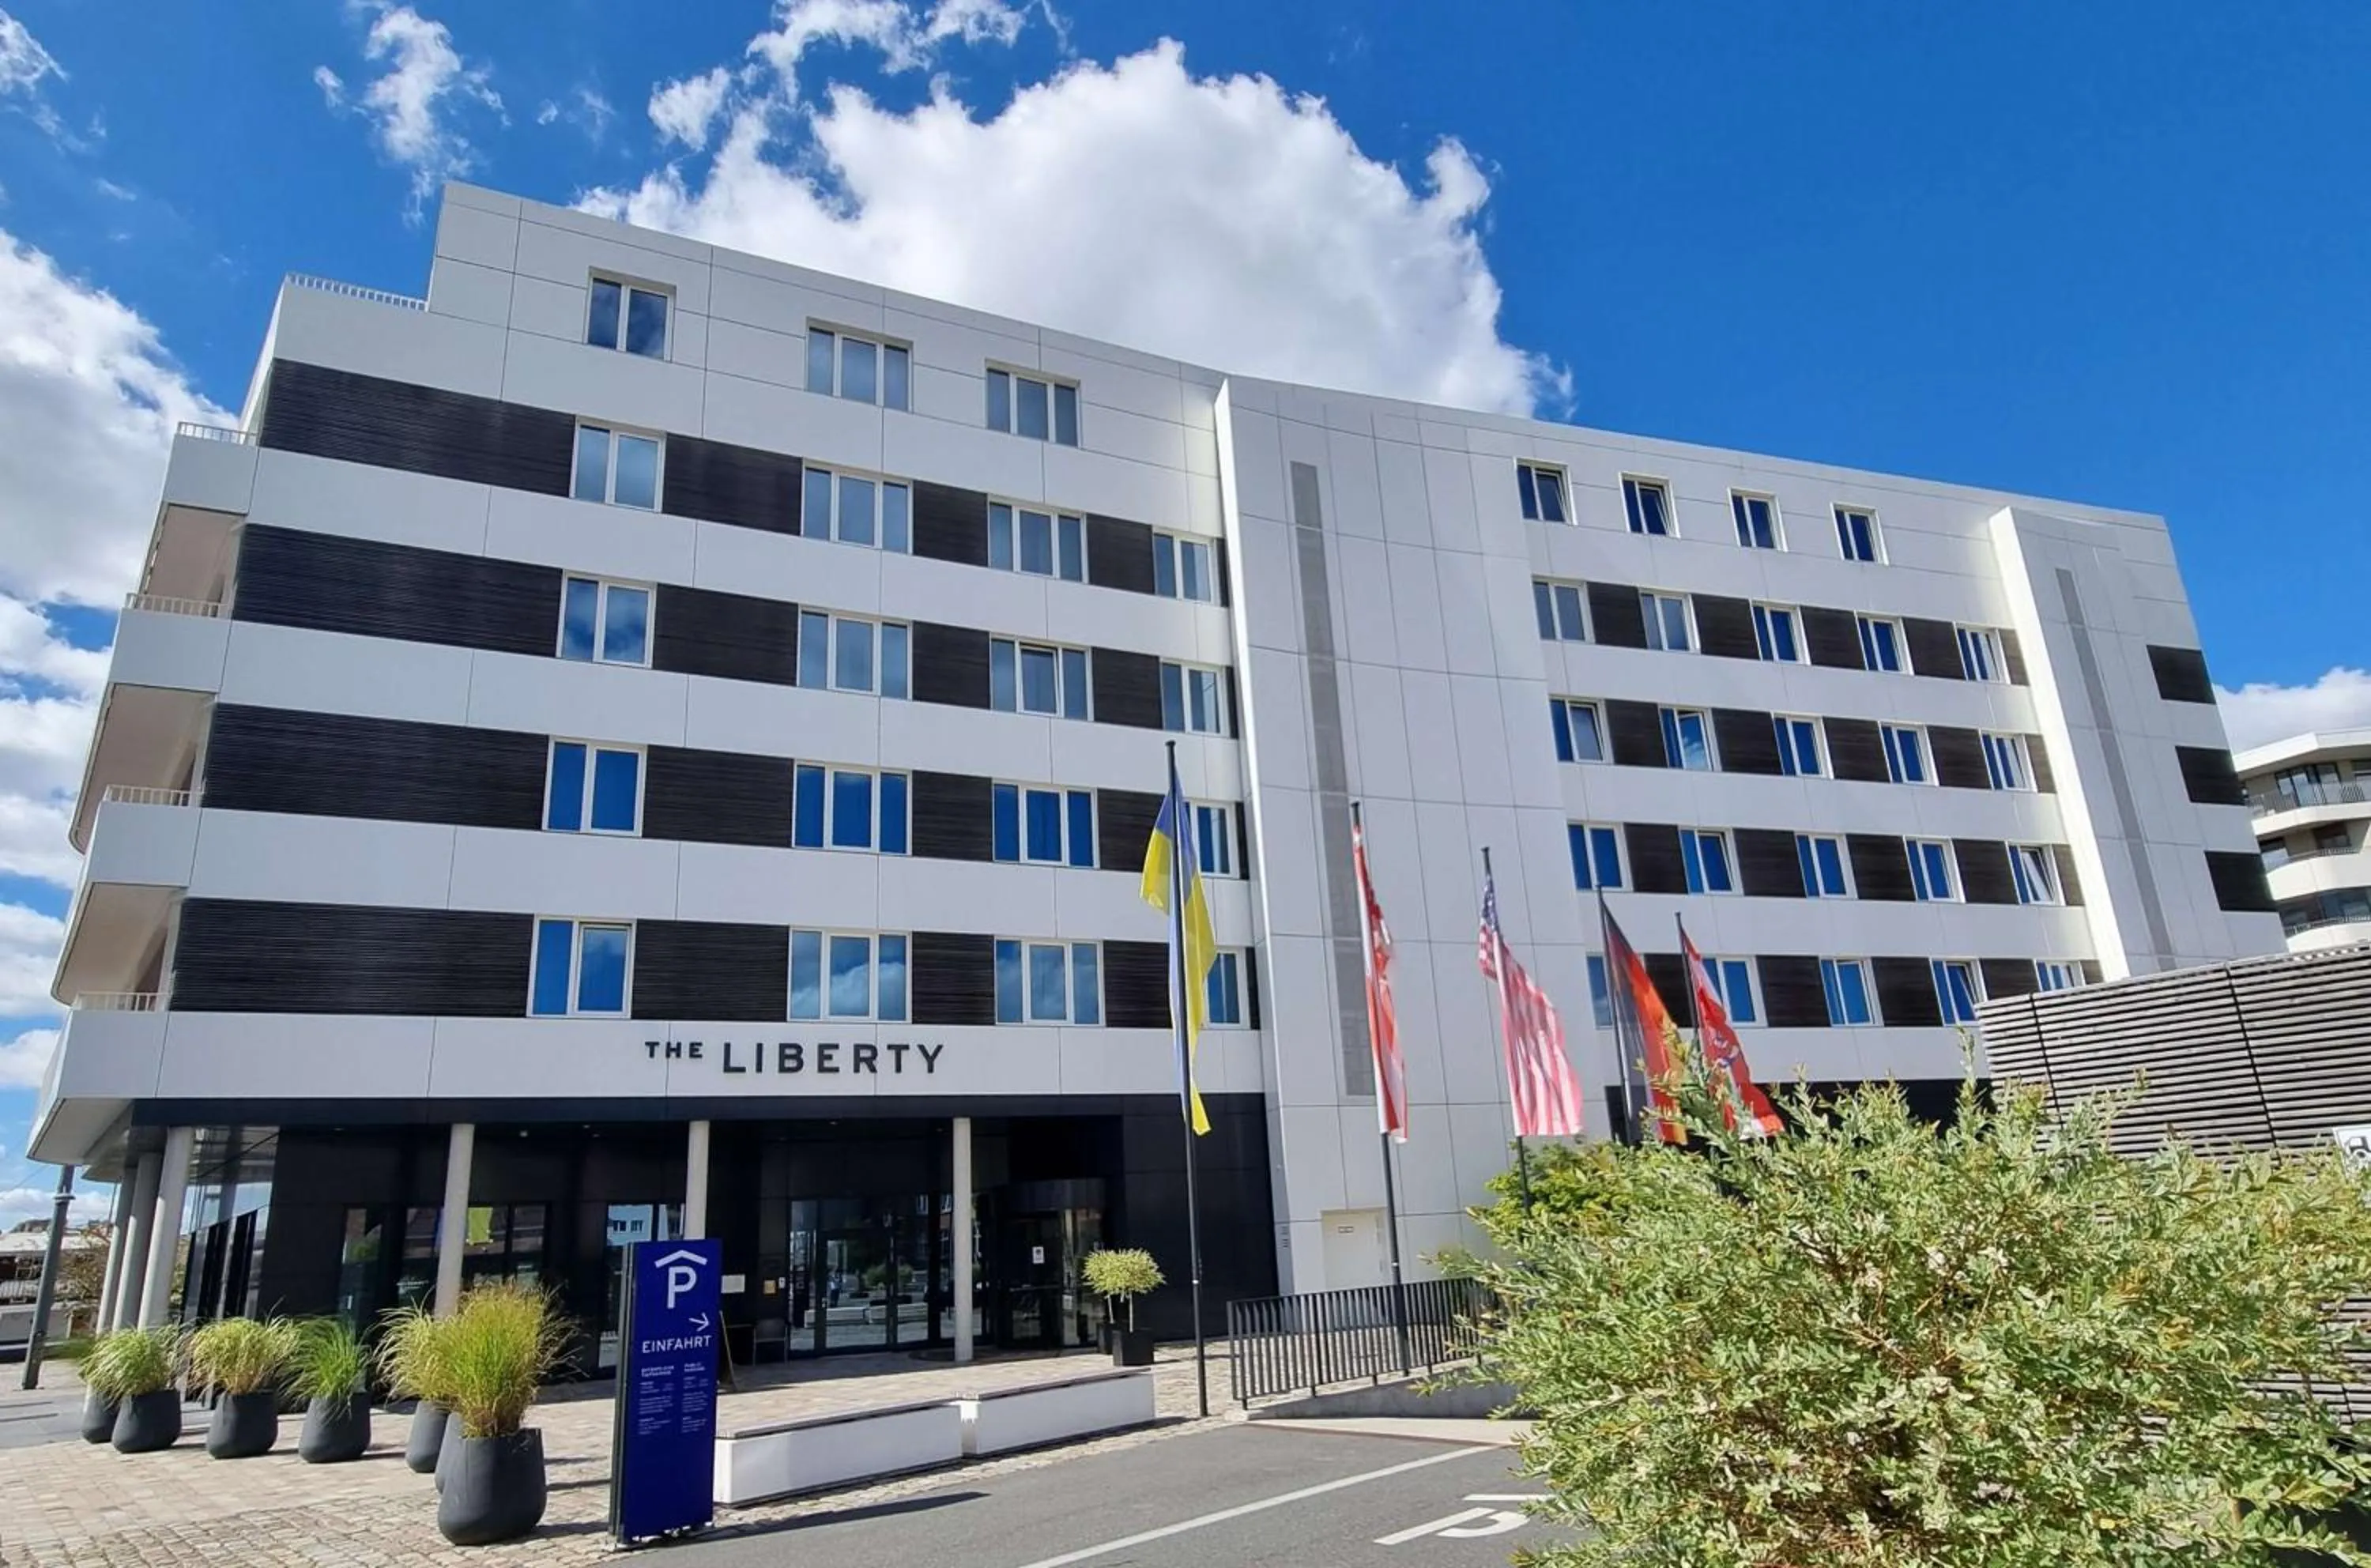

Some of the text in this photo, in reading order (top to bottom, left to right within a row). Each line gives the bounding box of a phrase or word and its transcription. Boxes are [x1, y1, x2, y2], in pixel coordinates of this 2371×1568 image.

[645, 1041, 944, 1073] THE LIBERTY
[667, 1265, 697, 1309] P
[642, 1335, 712, 1354] EINFAHRT
